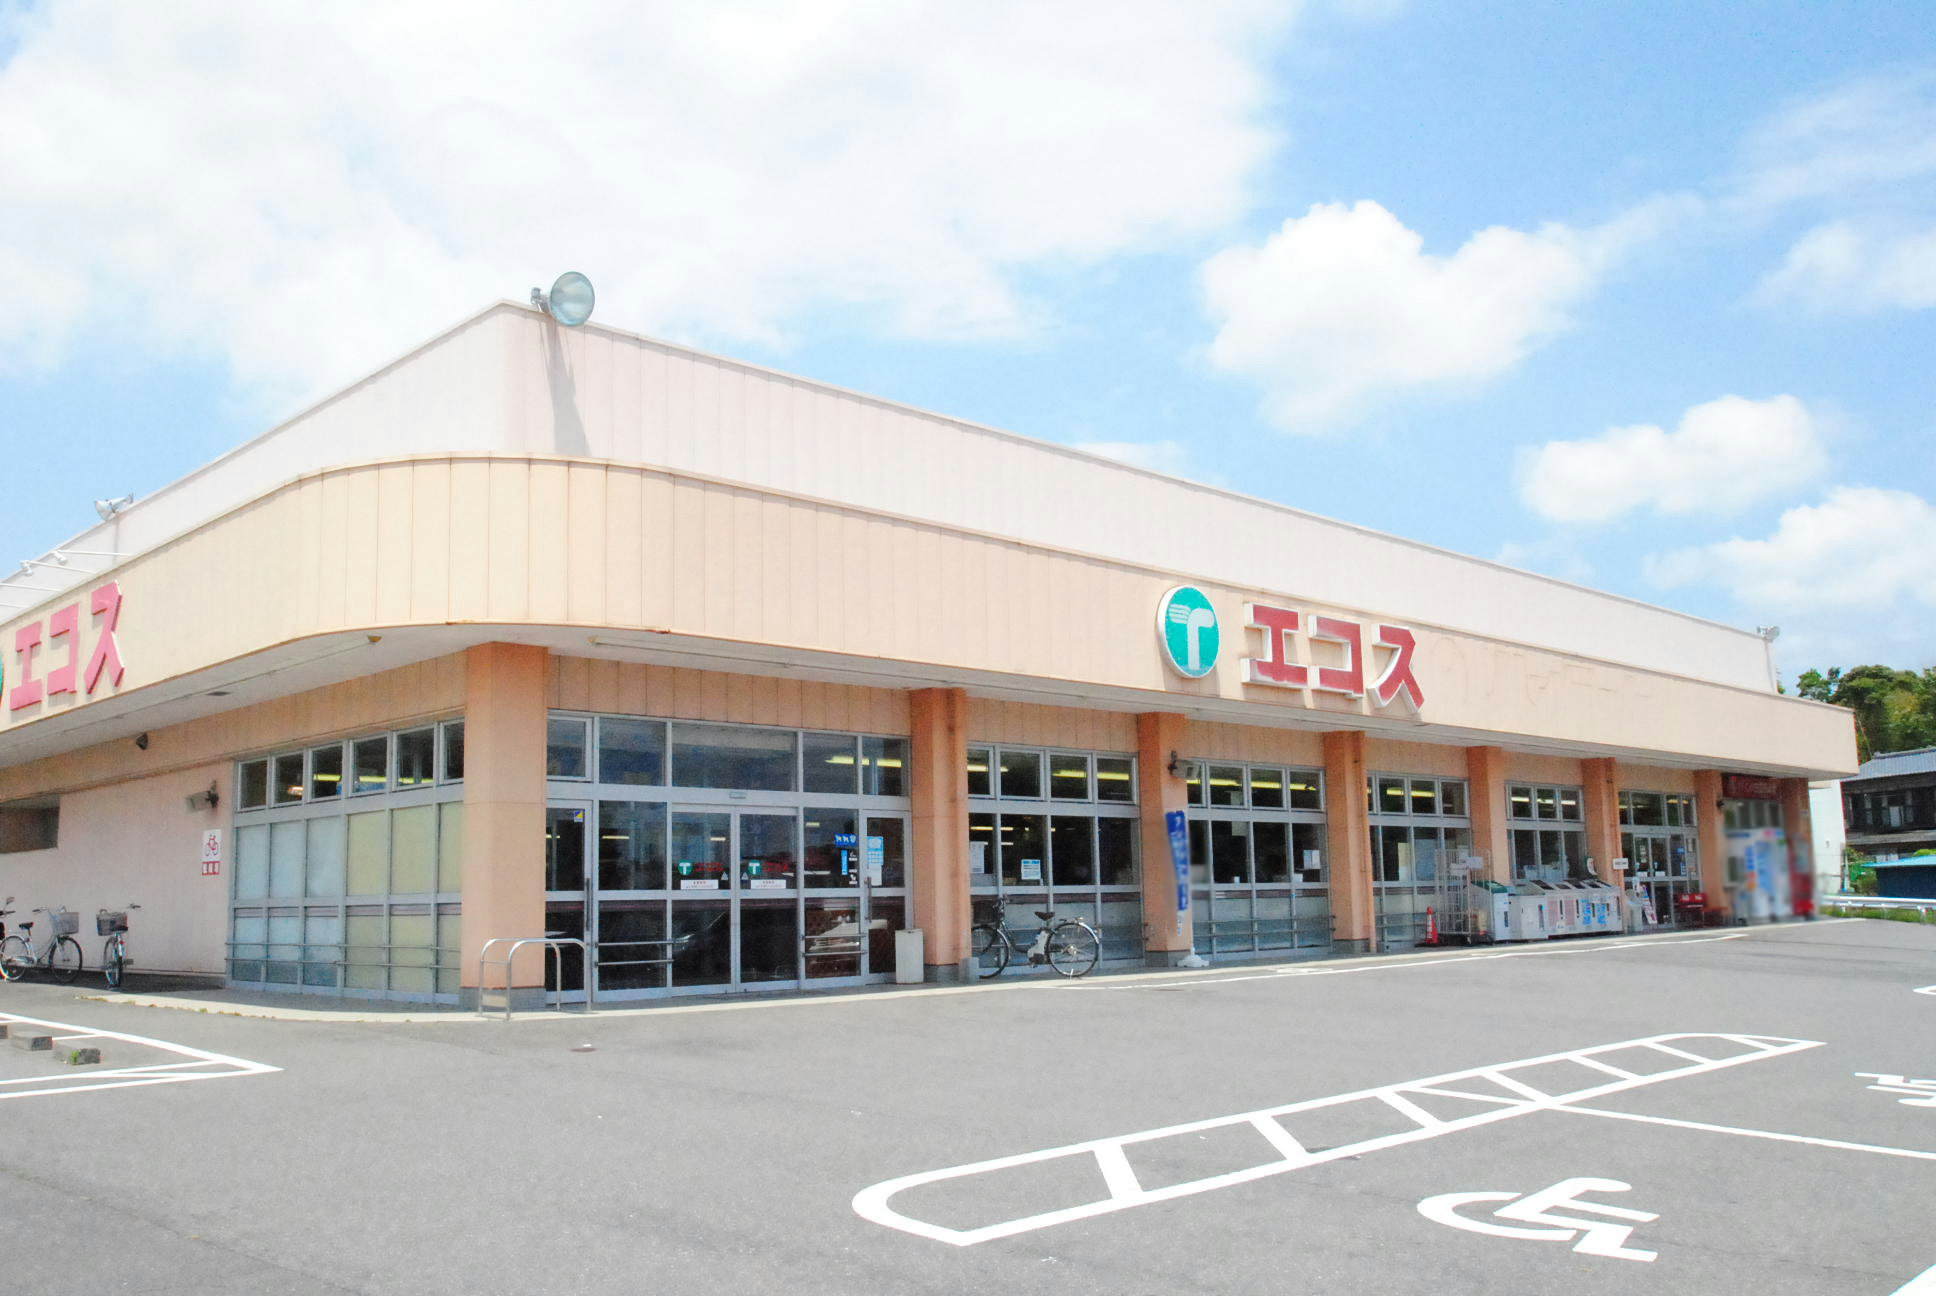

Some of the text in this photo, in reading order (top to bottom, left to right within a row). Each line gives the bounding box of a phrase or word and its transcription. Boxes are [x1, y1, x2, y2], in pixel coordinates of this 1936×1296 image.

[10, 580, 124, 711] エコス
[1241, 602, 1424, 713] エコス
